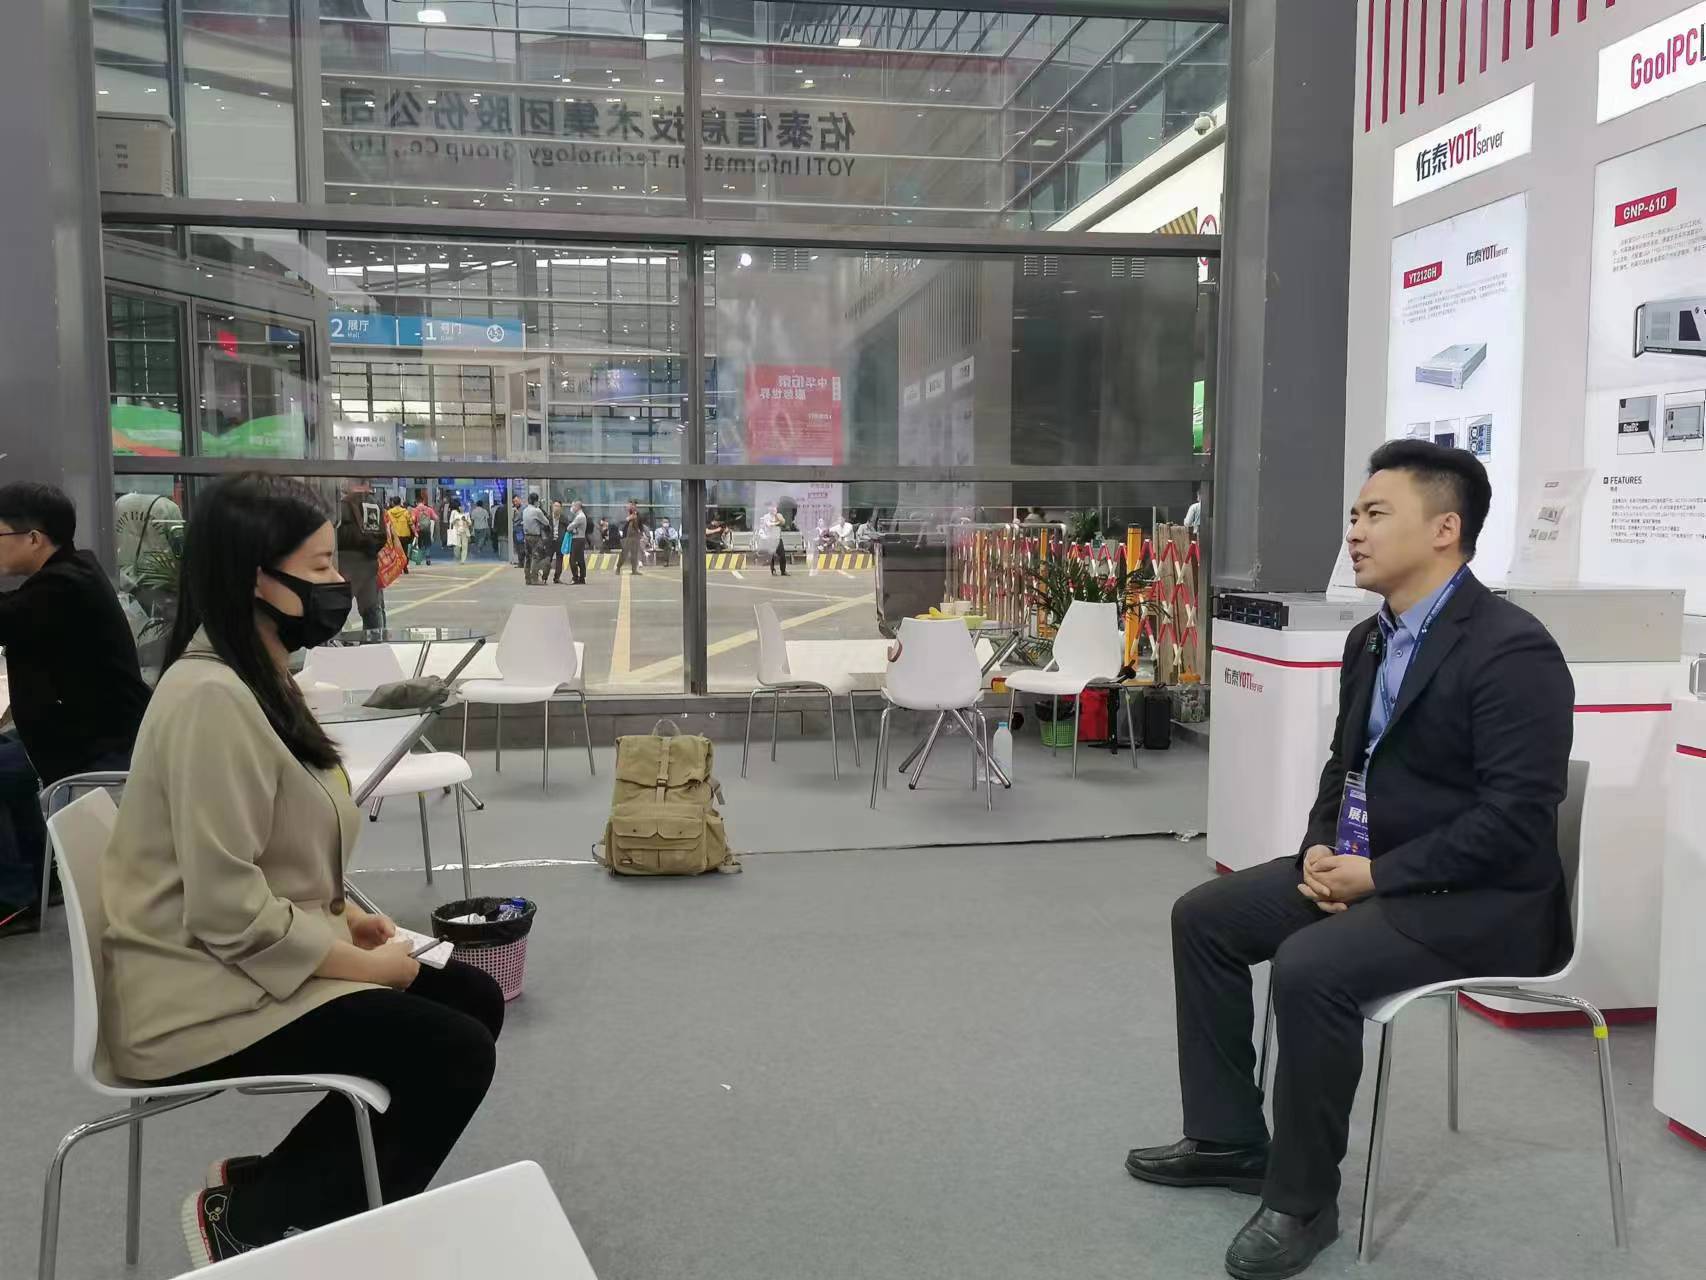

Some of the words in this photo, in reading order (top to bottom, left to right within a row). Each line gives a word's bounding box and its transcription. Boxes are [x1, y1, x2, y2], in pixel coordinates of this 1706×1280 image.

[1623, 195, 1668, 220] GNP-610
[330, 318, 345, 338] 2
[1610, 475, 1643, 485] FEATURES
